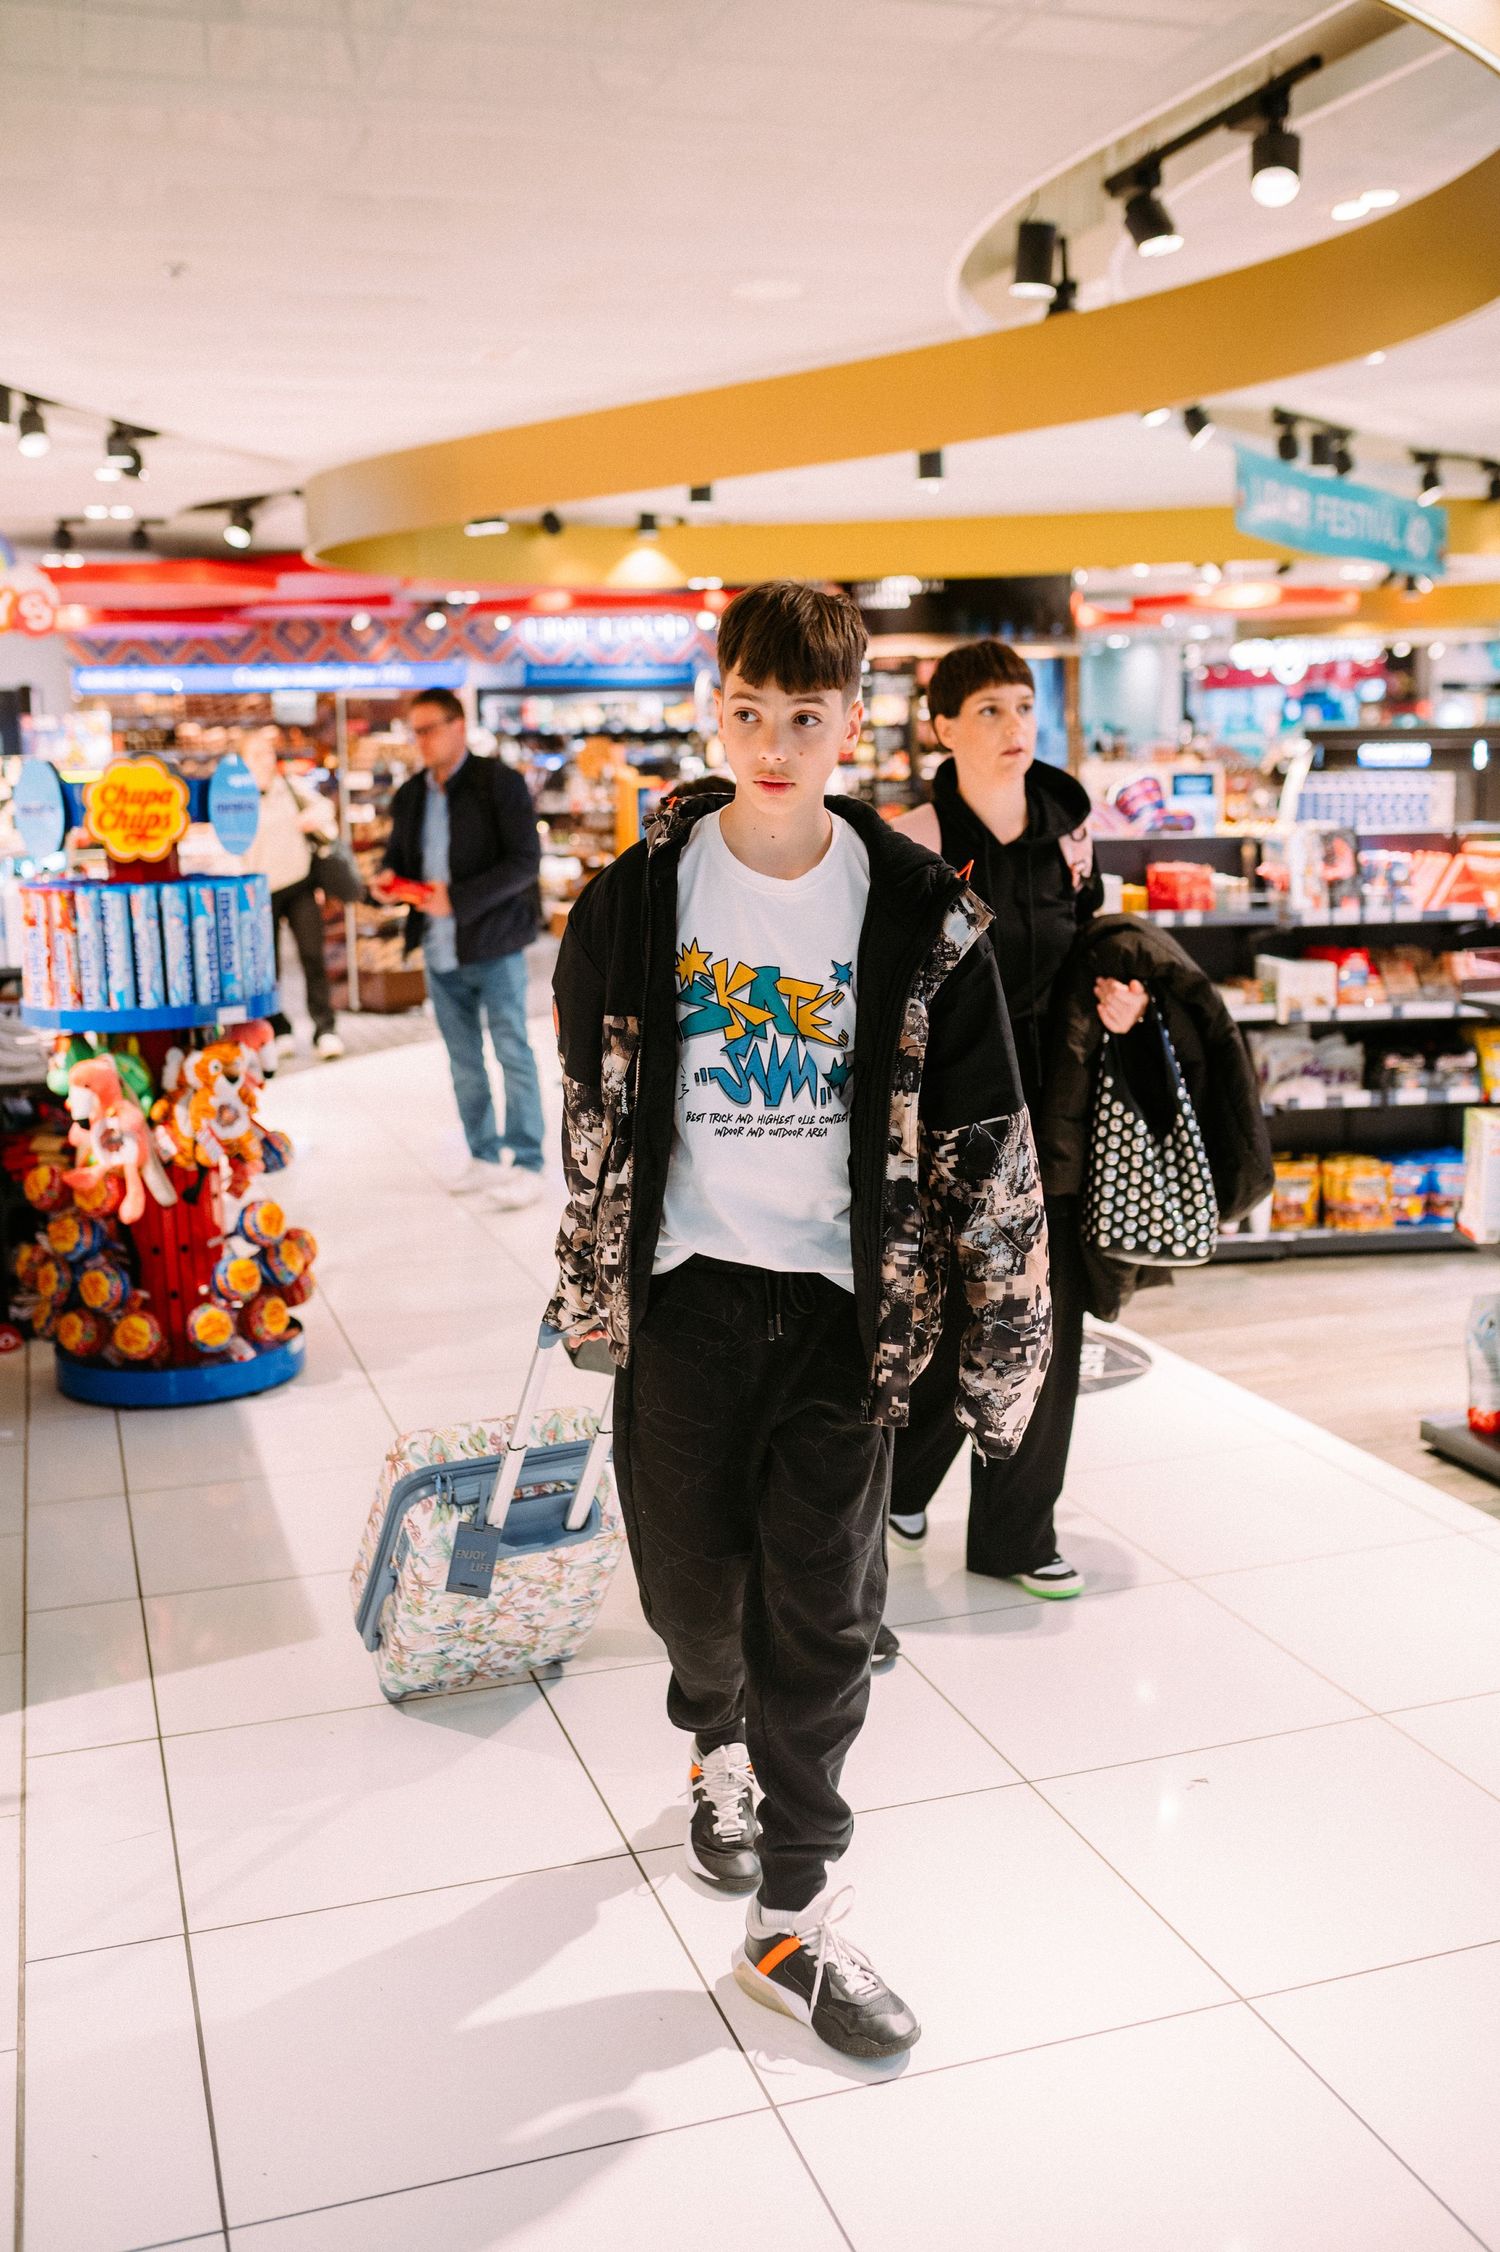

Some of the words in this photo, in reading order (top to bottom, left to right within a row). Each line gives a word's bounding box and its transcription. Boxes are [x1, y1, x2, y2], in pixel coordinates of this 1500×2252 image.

[99, 781, 174, 807] Chupa
[98, 807, 171, 832] Chups
[219, 891, 235, 971] mentos
[678, 958, 843, 1046] SKATE
[708, 1031, 817, 1107] JAM
[685, 1110, 707, 1124] BEST
[709, 1112, 734, 1124] TRICK
[735, 1113, 753, 1125] AND
[757, 1114, 795, 1125] HIGHEST
[819, 1111, 849, 1125] CONTEST
[714, 1126, 745, 1138] INDOOR
[746, 1126, 765, 1138] AND
[769, 1127, 804, 1138] OUTDOOR
[805, 1127, 828, 1138] AREA
[455, 1549, 487, 1560] ENJOY
[471, 1562, 493, 1572] LIFE
